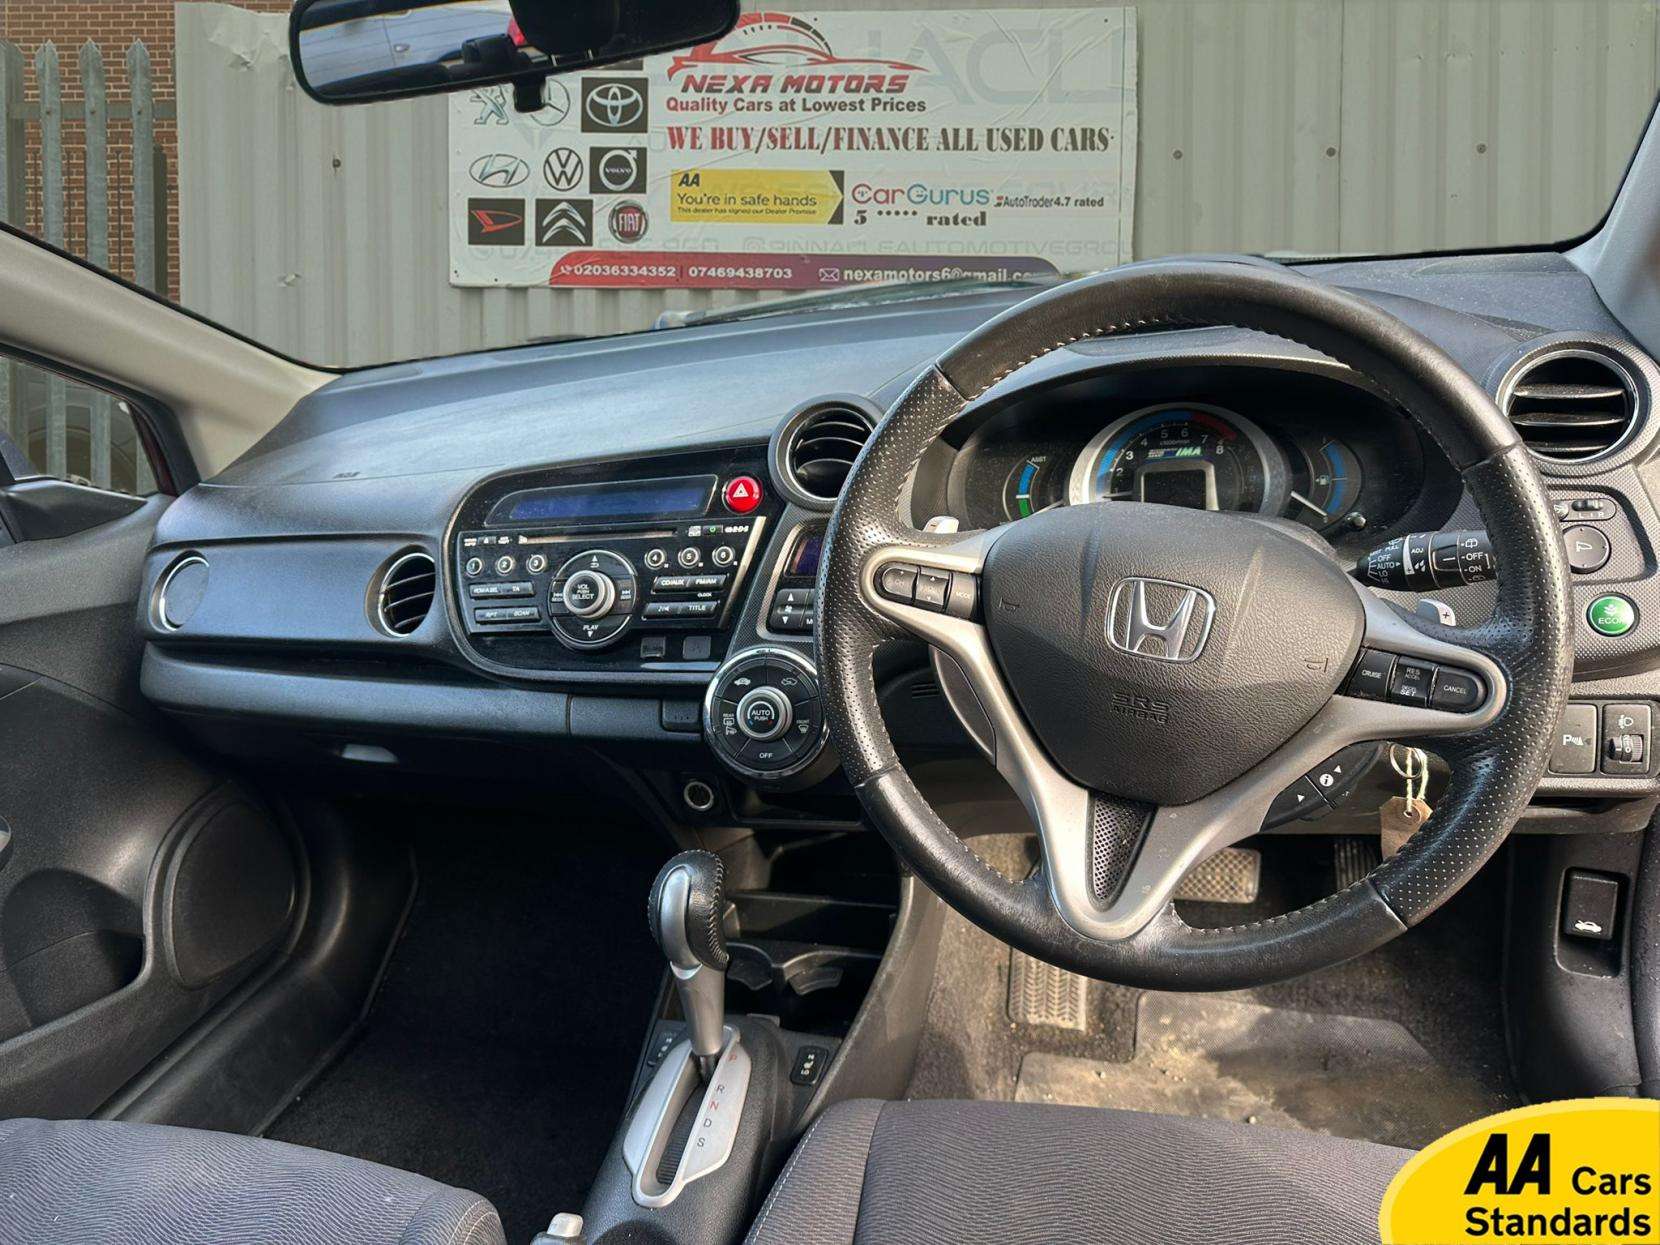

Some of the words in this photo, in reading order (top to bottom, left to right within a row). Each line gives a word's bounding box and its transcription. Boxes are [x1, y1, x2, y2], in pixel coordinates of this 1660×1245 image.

[681, 75, 773, 93] NEXA
[780, 75, 910, 93] MOTORS
[666, 97, 727, 114] Quality
[733, 98, 773, 112] Cars
[779, 98, 796, 112] at
[802, 98, 865, 112] Lowest
[871, 98, 926, 112] Prices
[667, 126, 702, 150] WE
[710, 126, 929, 154] BUY/SELL/FINANCE
[936, 128, 979, 151] ALL
[986, 128, 1044, 151] USED
[1051, 128, 1110, 151] CARS
[678, 173, 700, 187] AA
[677, 193, 720, 205] You're
[724, 193, 737, 205] in
[740, 193, 770, 206] safe
[773, 194, 817, 206] hands
[851, 183, 990, 205] CarGurus
[1074, 196, 1104, 207] rated
[618, 213, 641, 232] FIAT
[853, 210, 868, 225] 5
[926, 211, 987, 226] rated
[574, 265, 676, 276] 02036334352
[689, 267, 792, 279] 07469438703
[1125, 450, 1134, 460] 3
[1175, 446, 1202, 456] IMA
[1215, 445, 1224, 455] 8
[689, 603, 706, 611] TITLE
[1361, 669, 1382, 679] CRUISE
[1400, 688, 1416, 696] SET
[1443, 684, 1467, 694] CANCEL
[716, 1085, 725, 1094] R
[709, 1101, 719, 1110] N
[703, 1118, 712, 1128] D
[697, 1138, 706, 1147] S
